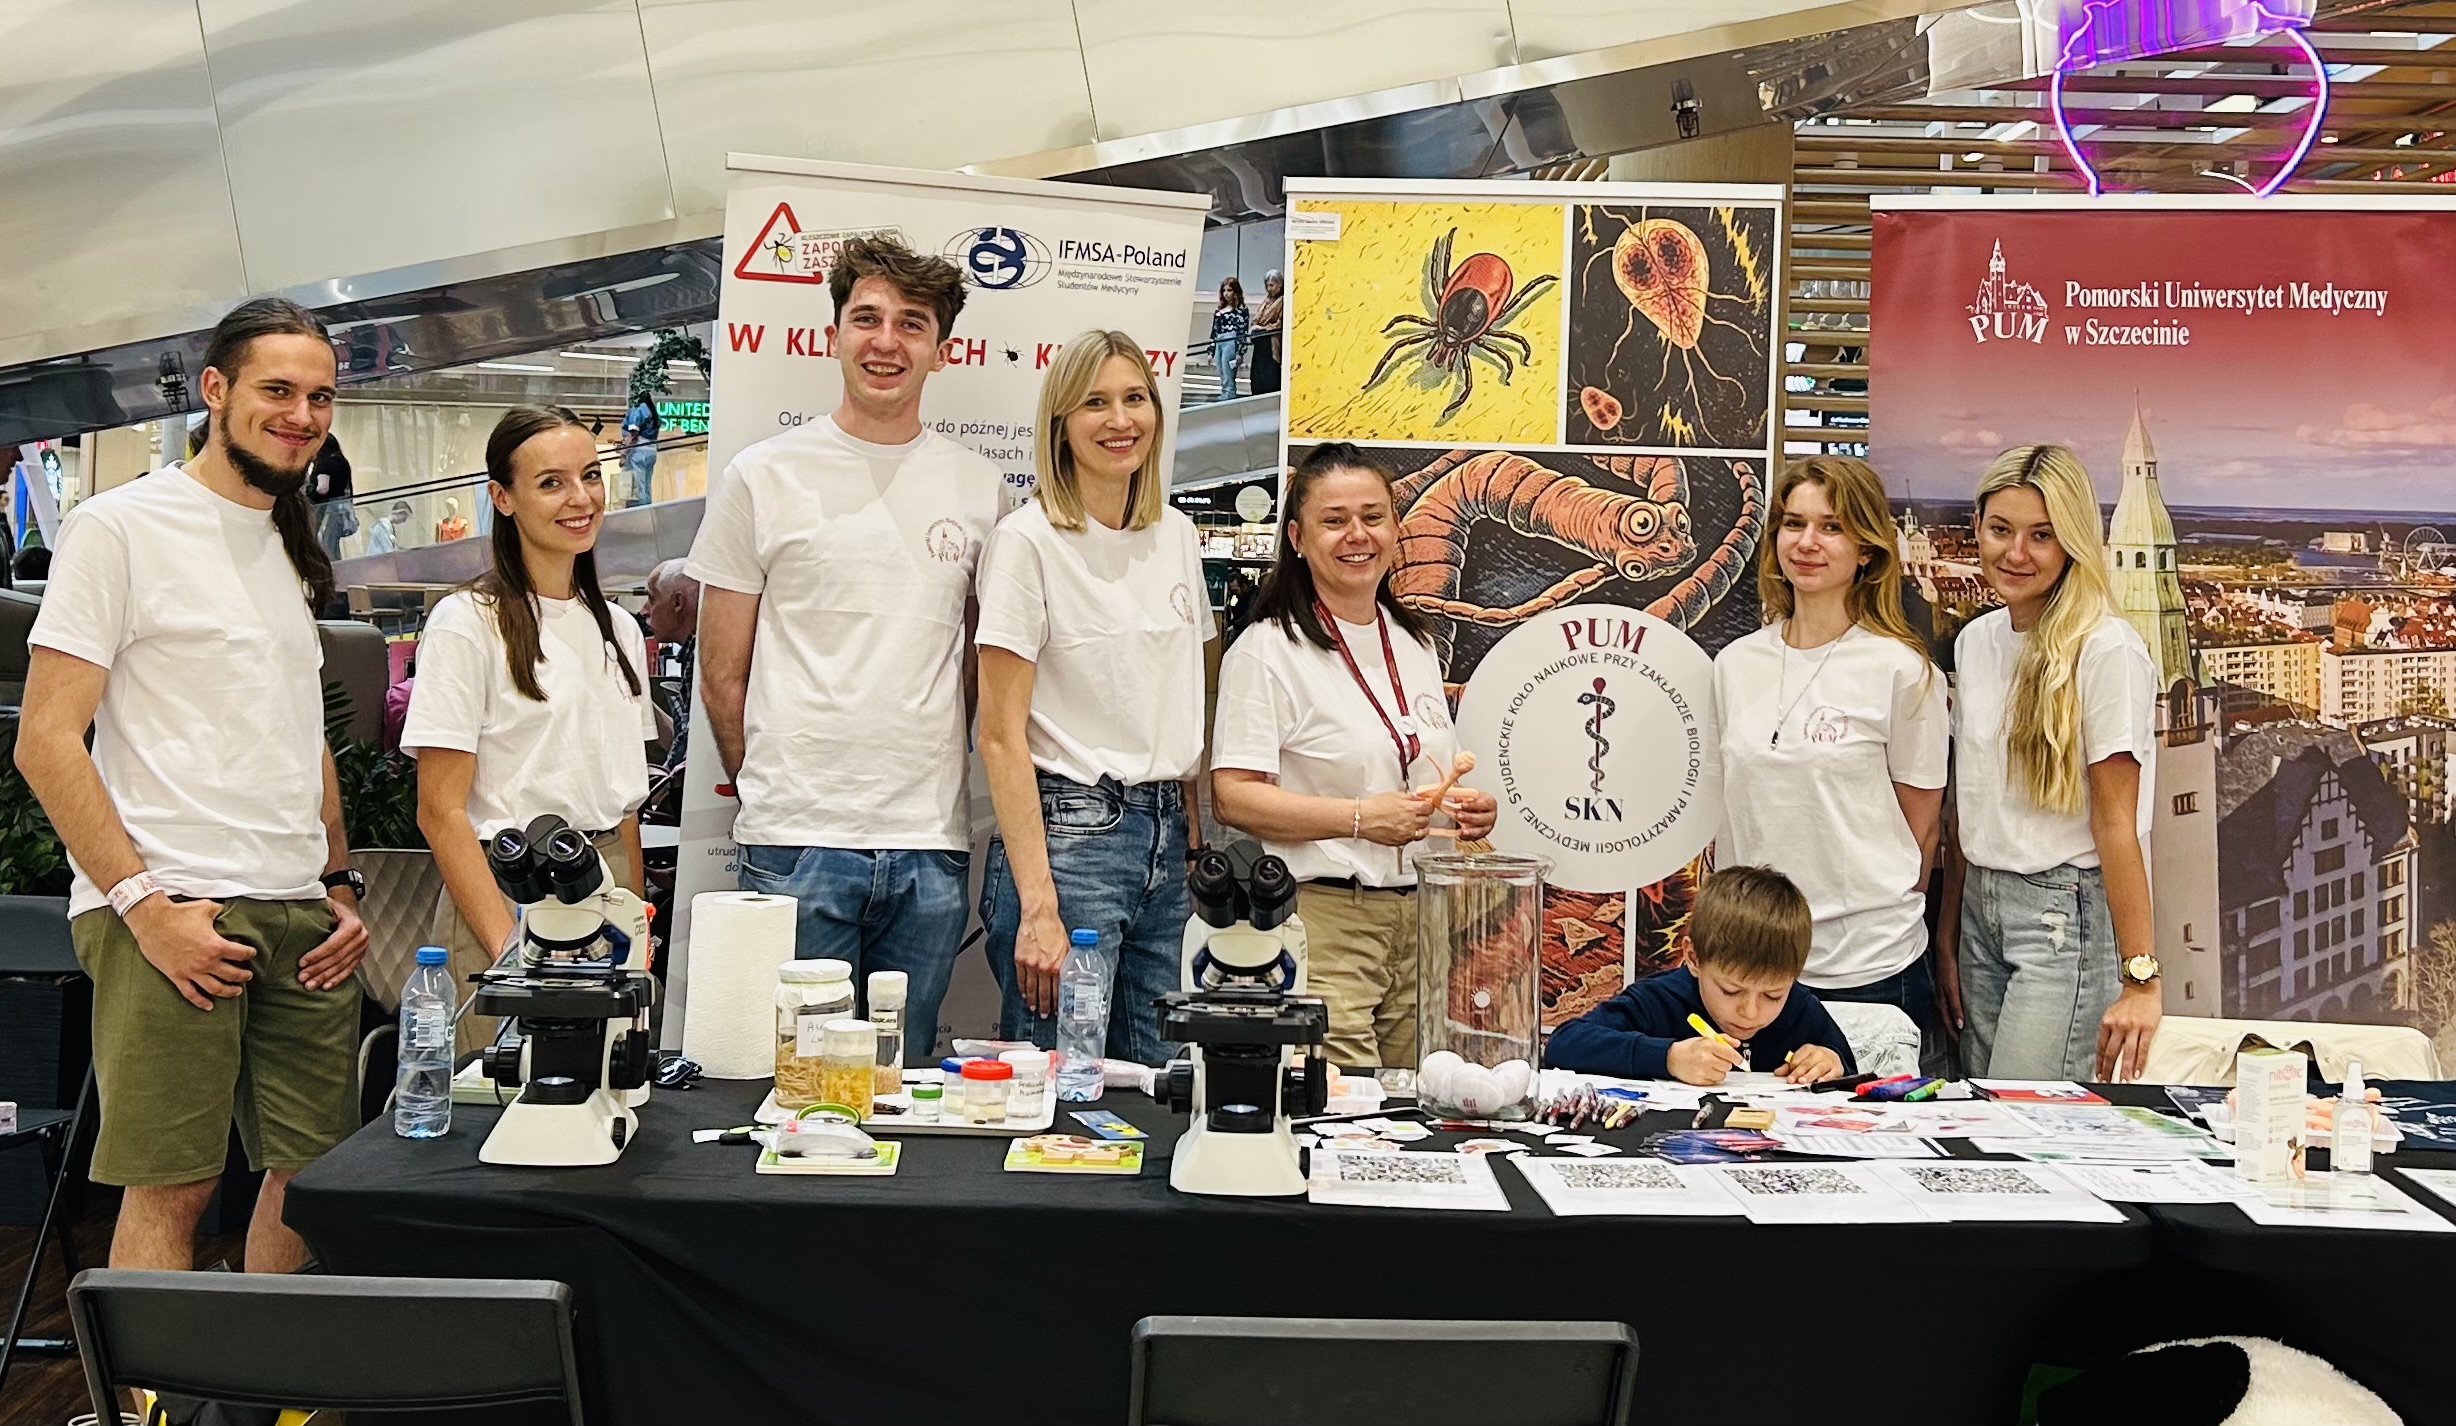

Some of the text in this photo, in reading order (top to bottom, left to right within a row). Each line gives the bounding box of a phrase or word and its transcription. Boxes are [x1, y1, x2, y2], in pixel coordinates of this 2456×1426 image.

[801, 241, 841, 256] ZAPO
[803, 256, 837, 270] ZASZ
[1058, 239, 1187, 268] IFMSA-Poland
[2064, 280, 2389, 317] Pomorski Uniwersytet Medyczny
[727, 322, 765, 354] W
[1967, 311, 2050, 345] PUM
[2064, 318, 2190, 346] w Szczecinie
[656, 401, 711, 417] UNITED
[680, 417, 710, 433] BEN
[778, 410, 1034, 441] Od do późnej jes
[1559, 617, 1649, 655] PUM
[1533, 652, 1599, 684] NAUKOWE
[1603, 652, 1639, 670] PRZY
[1507, 682, 1535, 715] KOŁO
[1638, 663, 1695, 724] ZAKŁADZIE
[1498, 716, 1522, 805] STUDENCKIE
[1685, 726, 1701, 788] BIOLOGII
[1563, 795, 1625, 823] SKN
[1518, 805, 1591, 853] MEDYCZNEJ
[1595, 797, 1688, 854] PARAZYTOLOGII
[707, 846, 737, 857] utrud
